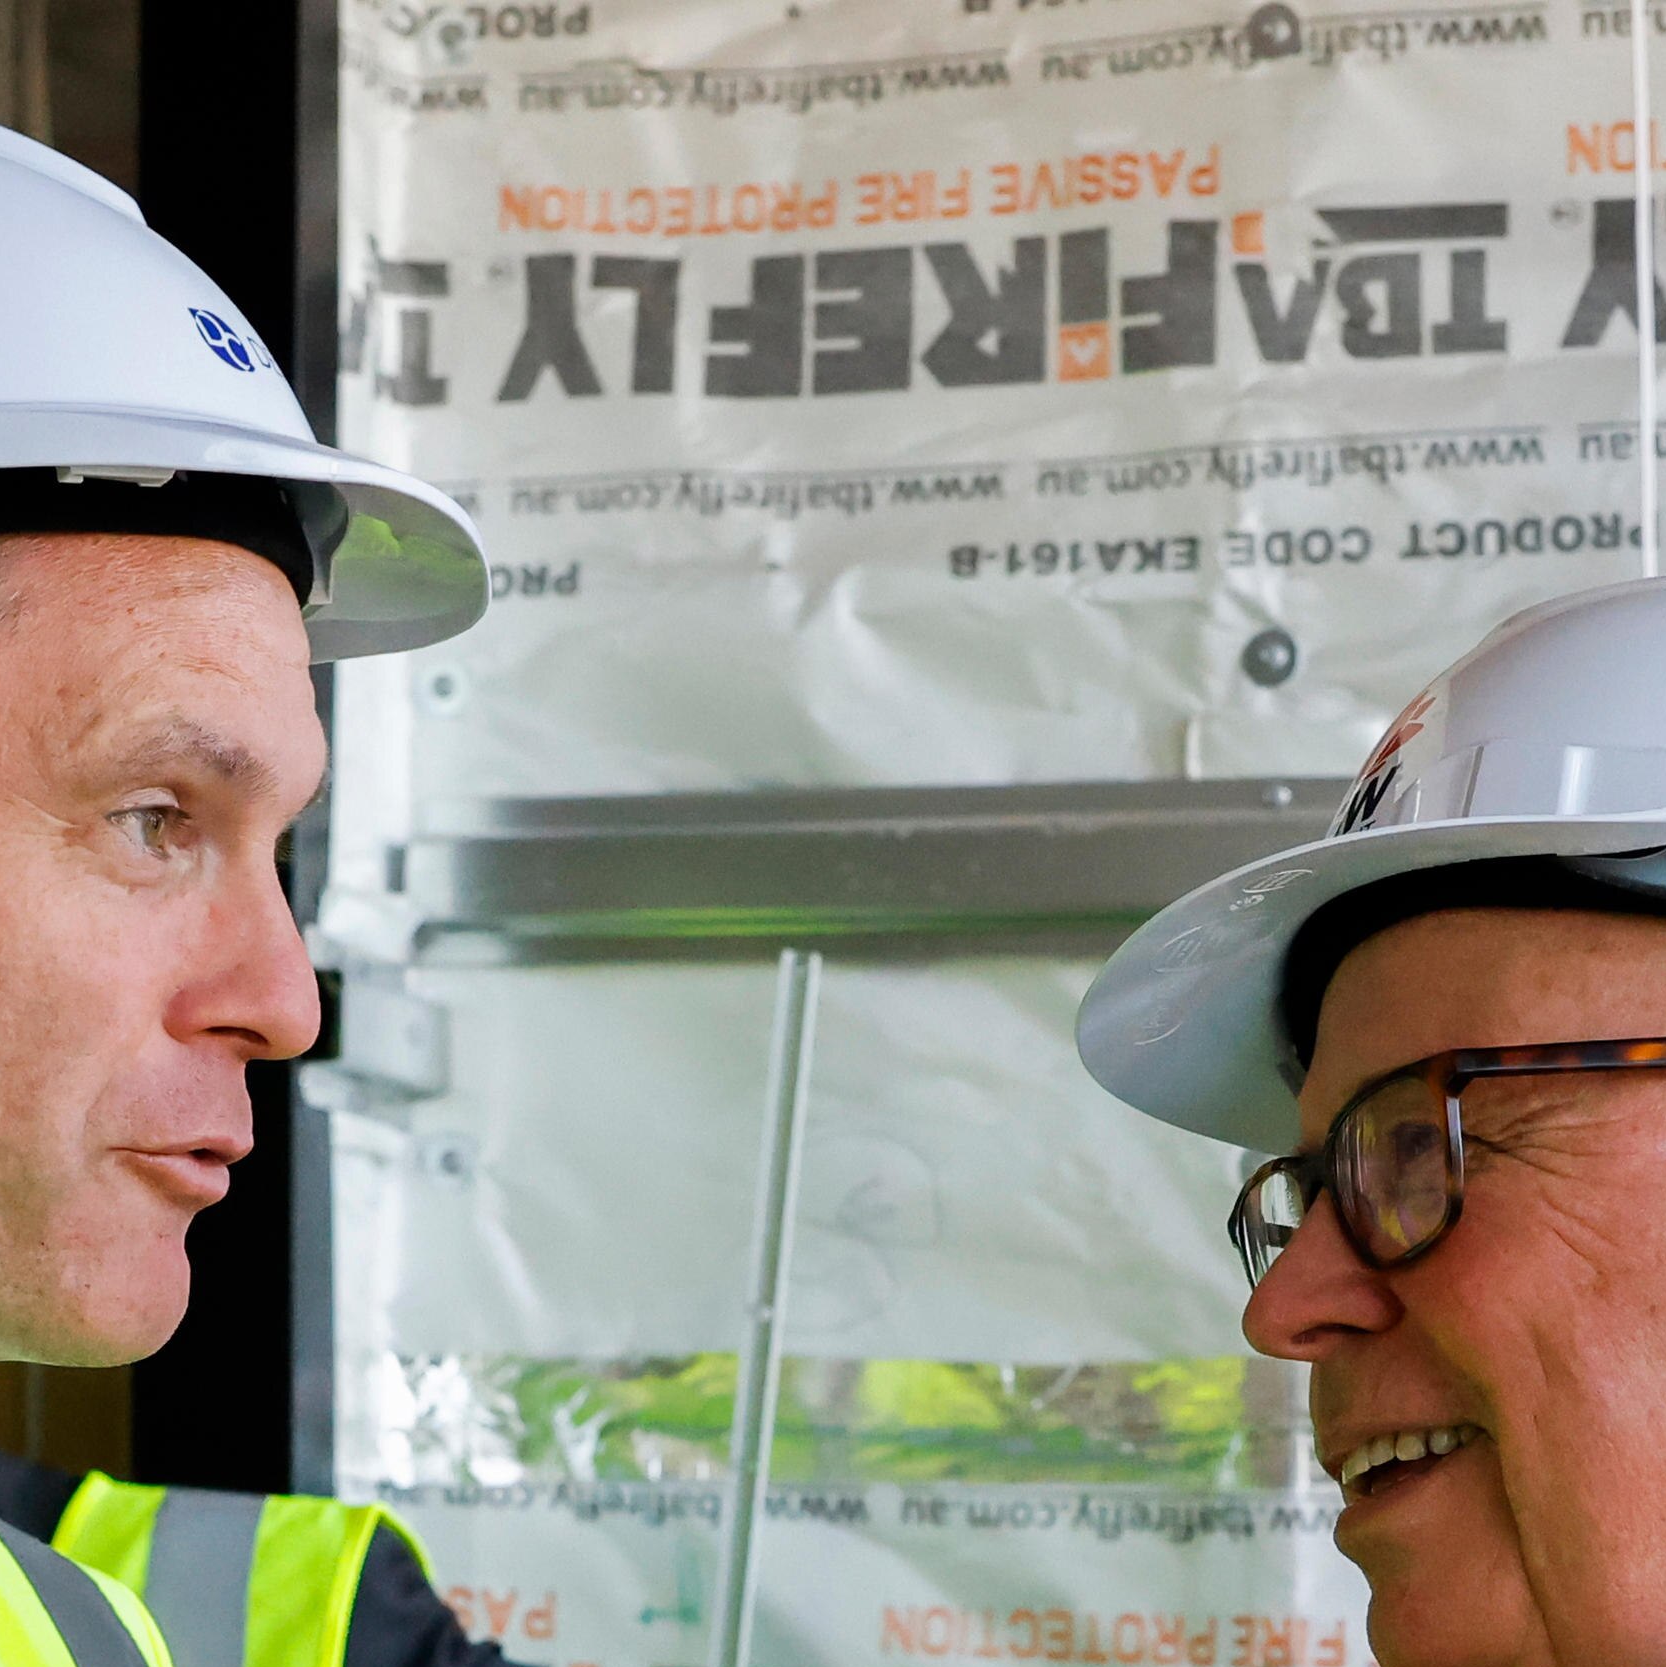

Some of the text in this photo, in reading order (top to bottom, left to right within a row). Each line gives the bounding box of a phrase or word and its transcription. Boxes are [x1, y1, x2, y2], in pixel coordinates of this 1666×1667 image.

[498, 144, 1221, 237] PASSIVE FIRE PROTECTION
[949, 535, 1201, 577] EKA161-B
[1226, 525, 1373, 569] CODE
[879, 1603, 1218, 1667] PROTECTION
